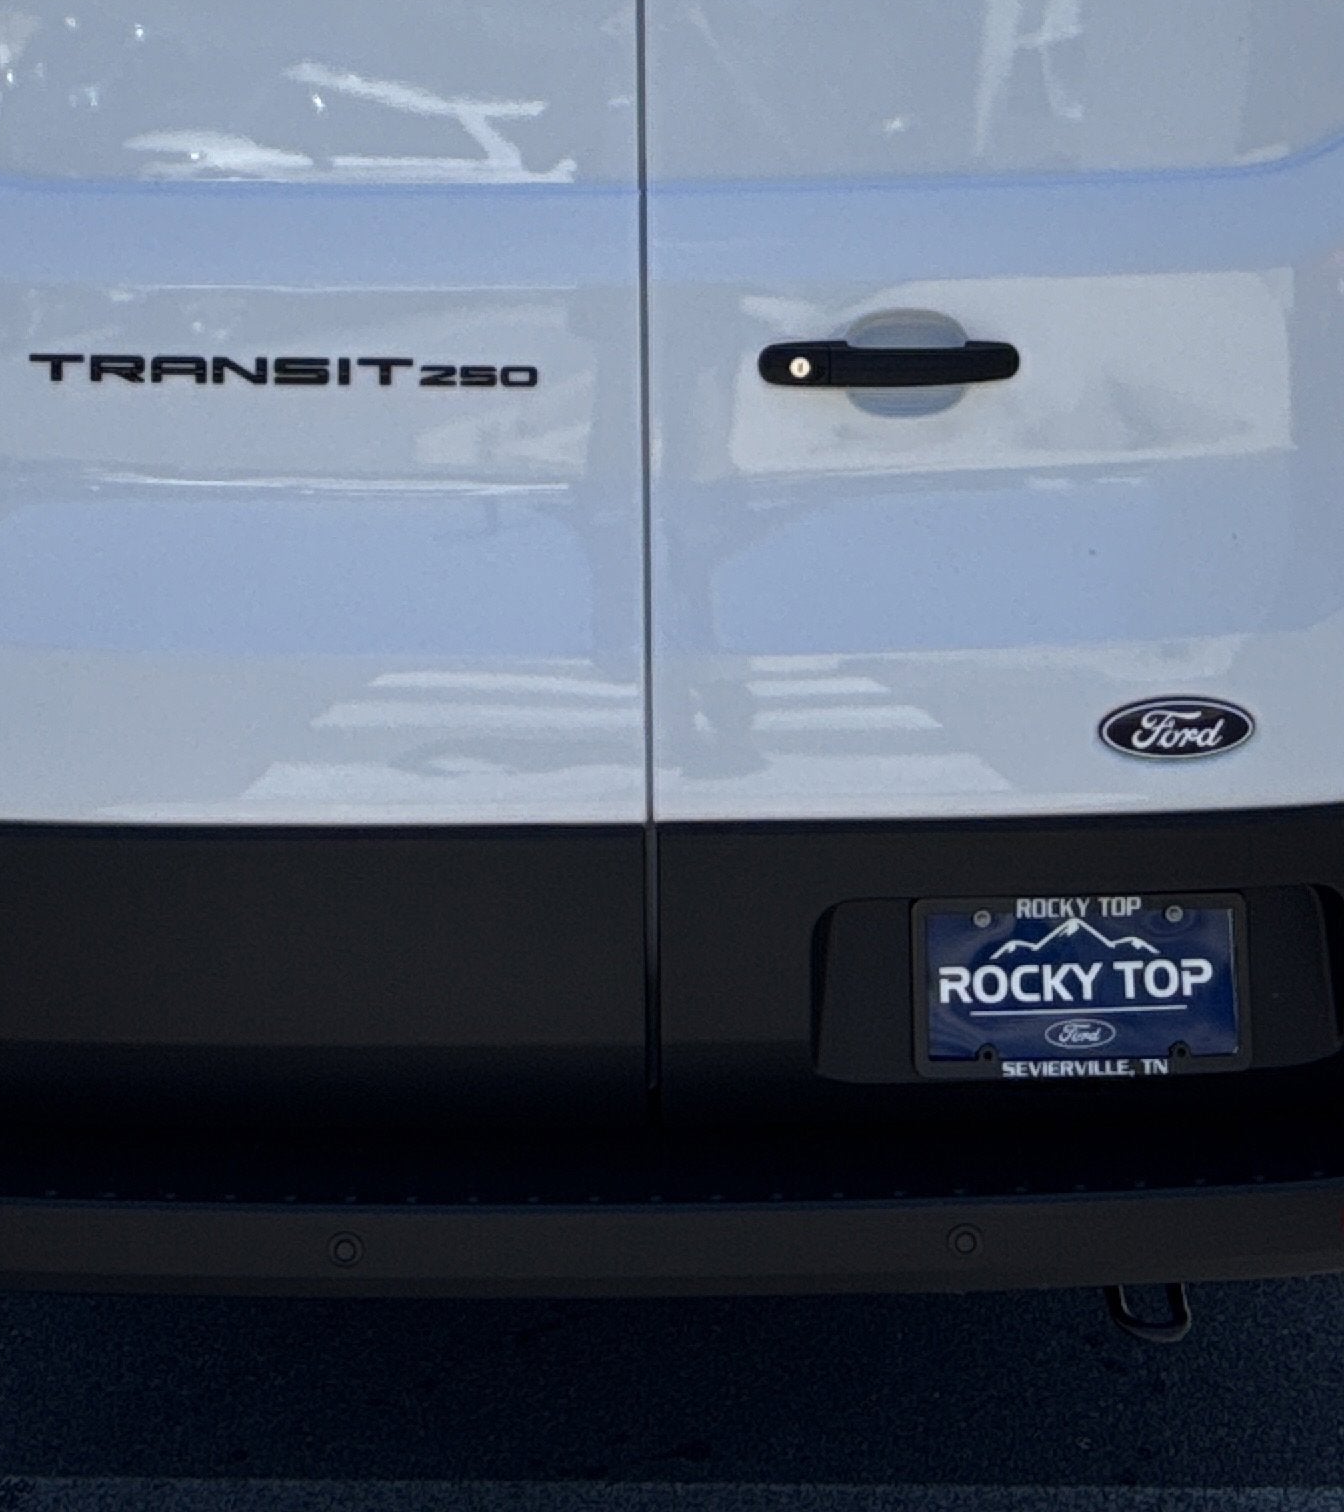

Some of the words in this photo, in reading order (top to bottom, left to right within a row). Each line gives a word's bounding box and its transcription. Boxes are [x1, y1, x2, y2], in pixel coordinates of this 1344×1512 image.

[28, 353, 414, 387] TRANSIT
[419, 364, 538, 389] 250
[1130, 709, 1226, 750] Ford
[1016, 897, 1090, 919] ROCKY
[1098, 896, 1142, 917] TOP
[938, 961, 1103, 1004] ROCKY
[1112, 957, 1214, 1000] TOP
[1058, 1022, 1102, 1044] Ford
[1001, 1059, 1136, 1078] SEVIERVILLE,
[1141, 1058, 1170, 1076] TN
